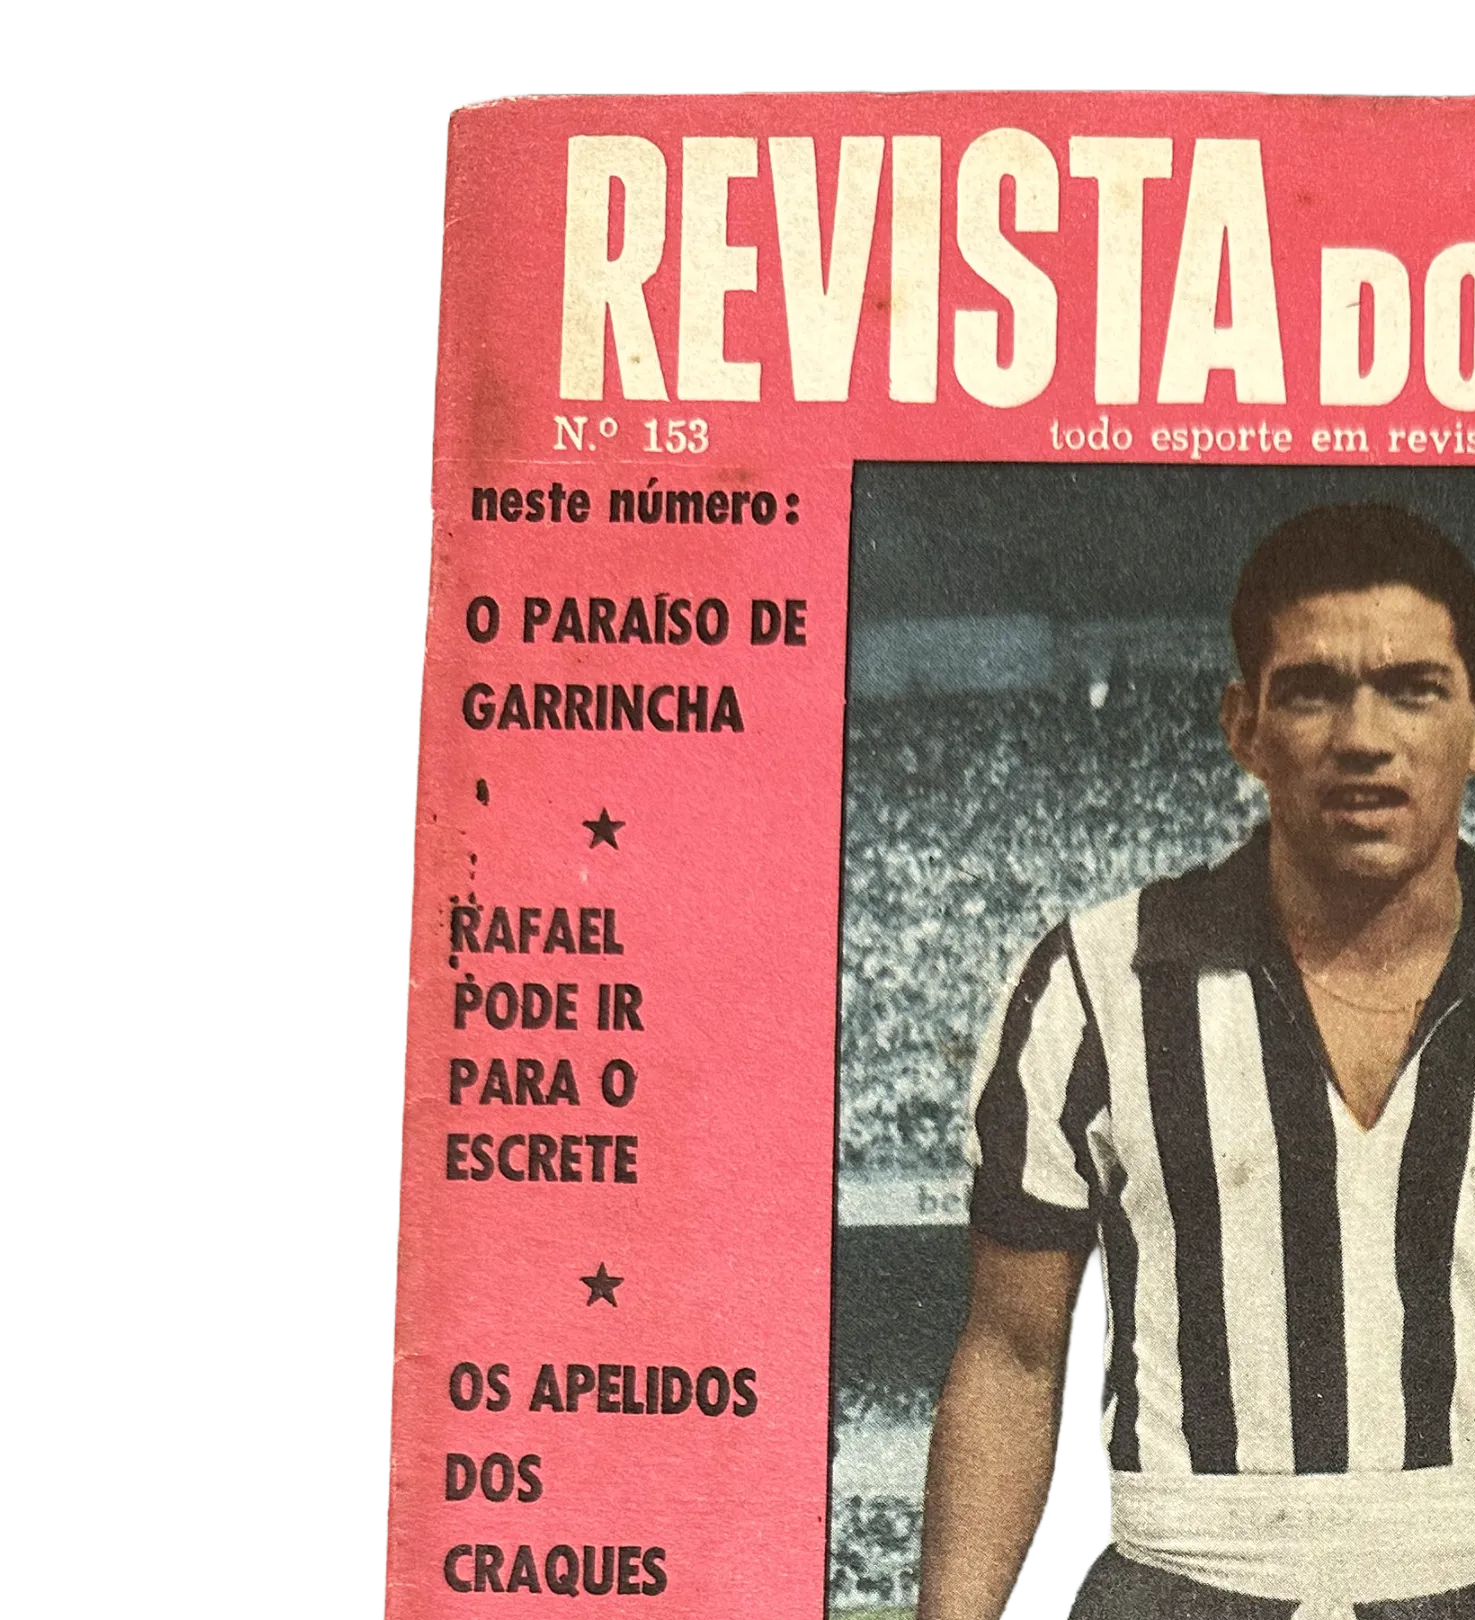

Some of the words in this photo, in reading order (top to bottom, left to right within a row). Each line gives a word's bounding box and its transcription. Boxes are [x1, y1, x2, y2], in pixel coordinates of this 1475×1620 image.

[559, 127, 1286, 408] REVISTA
[644, 418, 708, 453] 153
[1050, 419, 1132, 452] todo
[1151, 420, 1292, 459] esporte
[1312, 427, 1369, 452] em
[472, 483, 590, 522] neste
[609, 478, 799, 525] número:
[466, 596, 499, 643] O
[523, 593, 728, 645] PARAÍSO
[751, 599, 806, 645] DE
[462, 683, 744, 732] GARRINCHA
[450, 906, 624, 955] RAFAEL
[454, 982, 578, 1031] PODE
[598, 984, 643, 1031] IR
[450, 1058, 579, 1105] PARA
[600, 1059, 636, 1107] O
[446, 1134, 637, 1183] ESCRETE
[449, 1362, 510, 1411] OS
[529, 1364, 757, 1417] APELIDOS
[445, 1453, 542, 1502] DOS
[443, 1544, 667, 1597] CRAQUES
